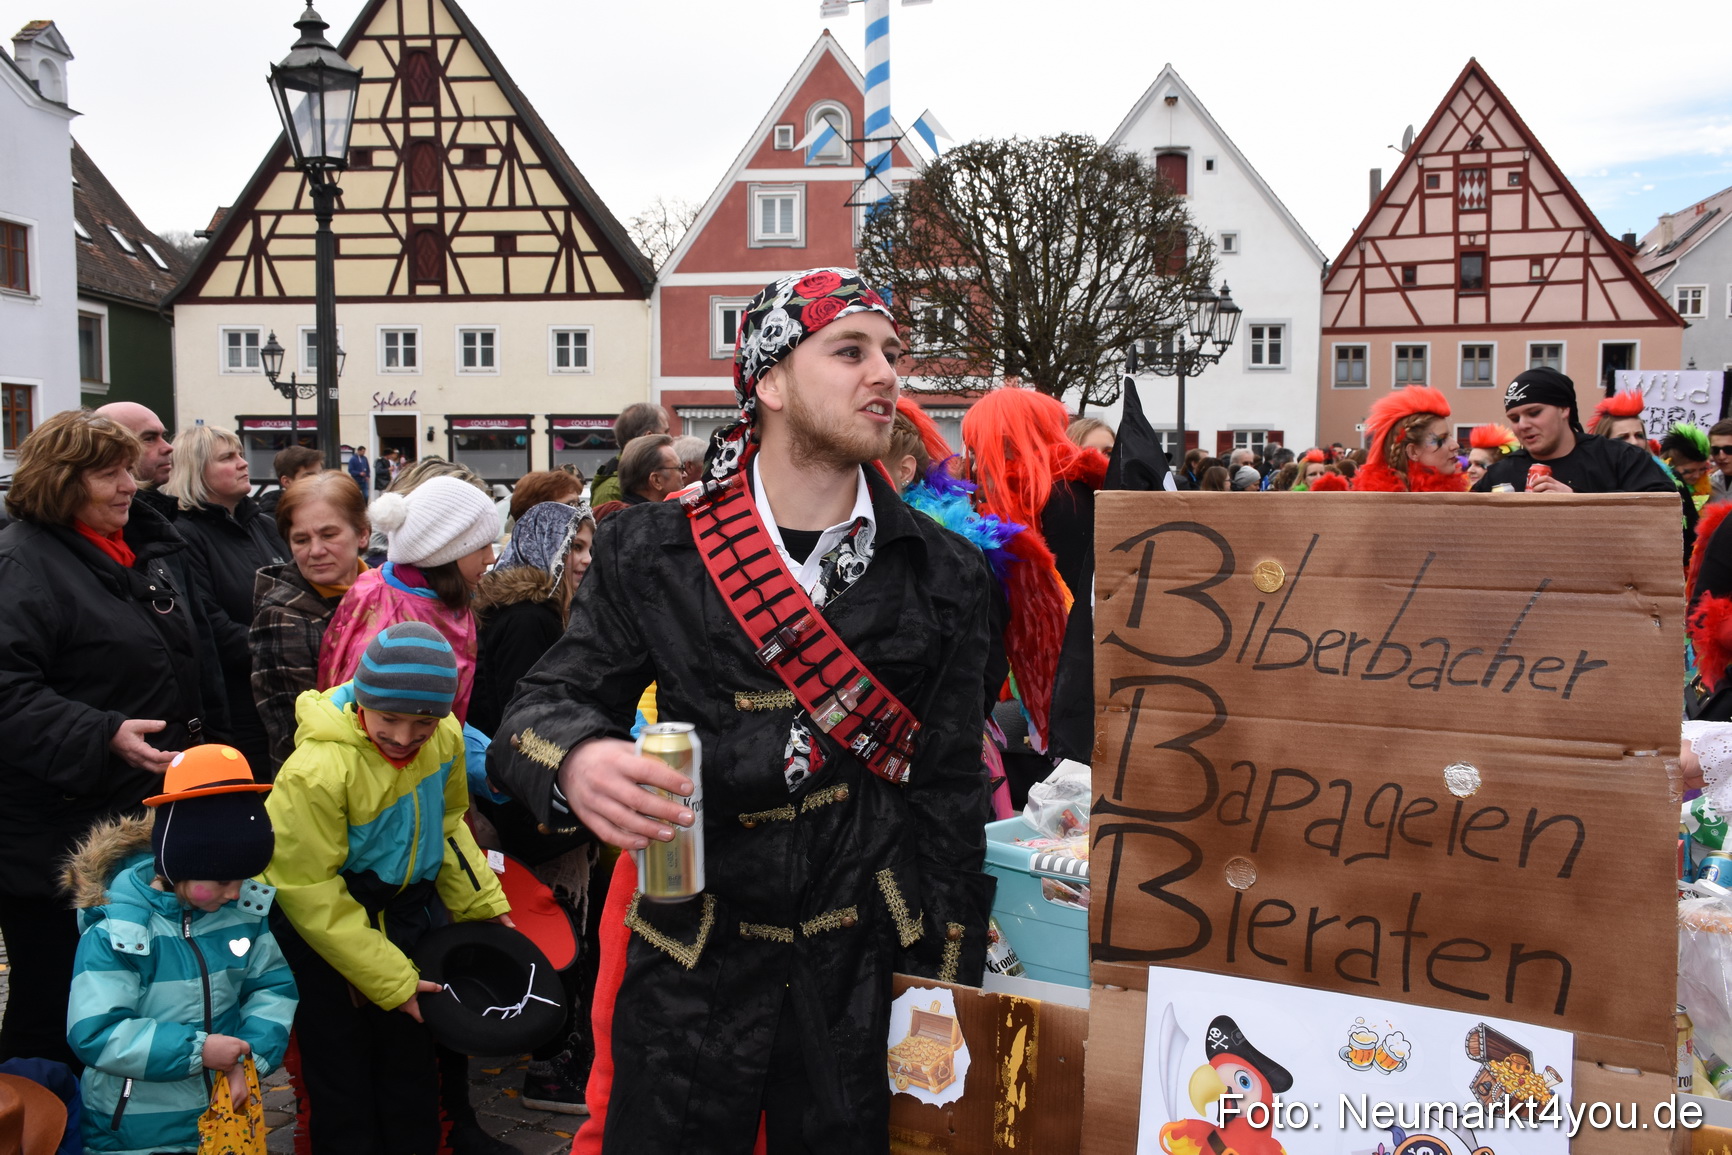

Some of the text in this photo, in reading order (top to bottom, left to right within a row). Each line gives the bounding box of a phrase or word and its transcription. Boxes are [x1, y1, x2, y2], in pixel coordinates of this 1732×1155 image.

[372, 390, 417, 412] Splash
[1101, 521, 1608, 699] Biberbacher
[1091, 822, 1572, 1016] Bieraten
